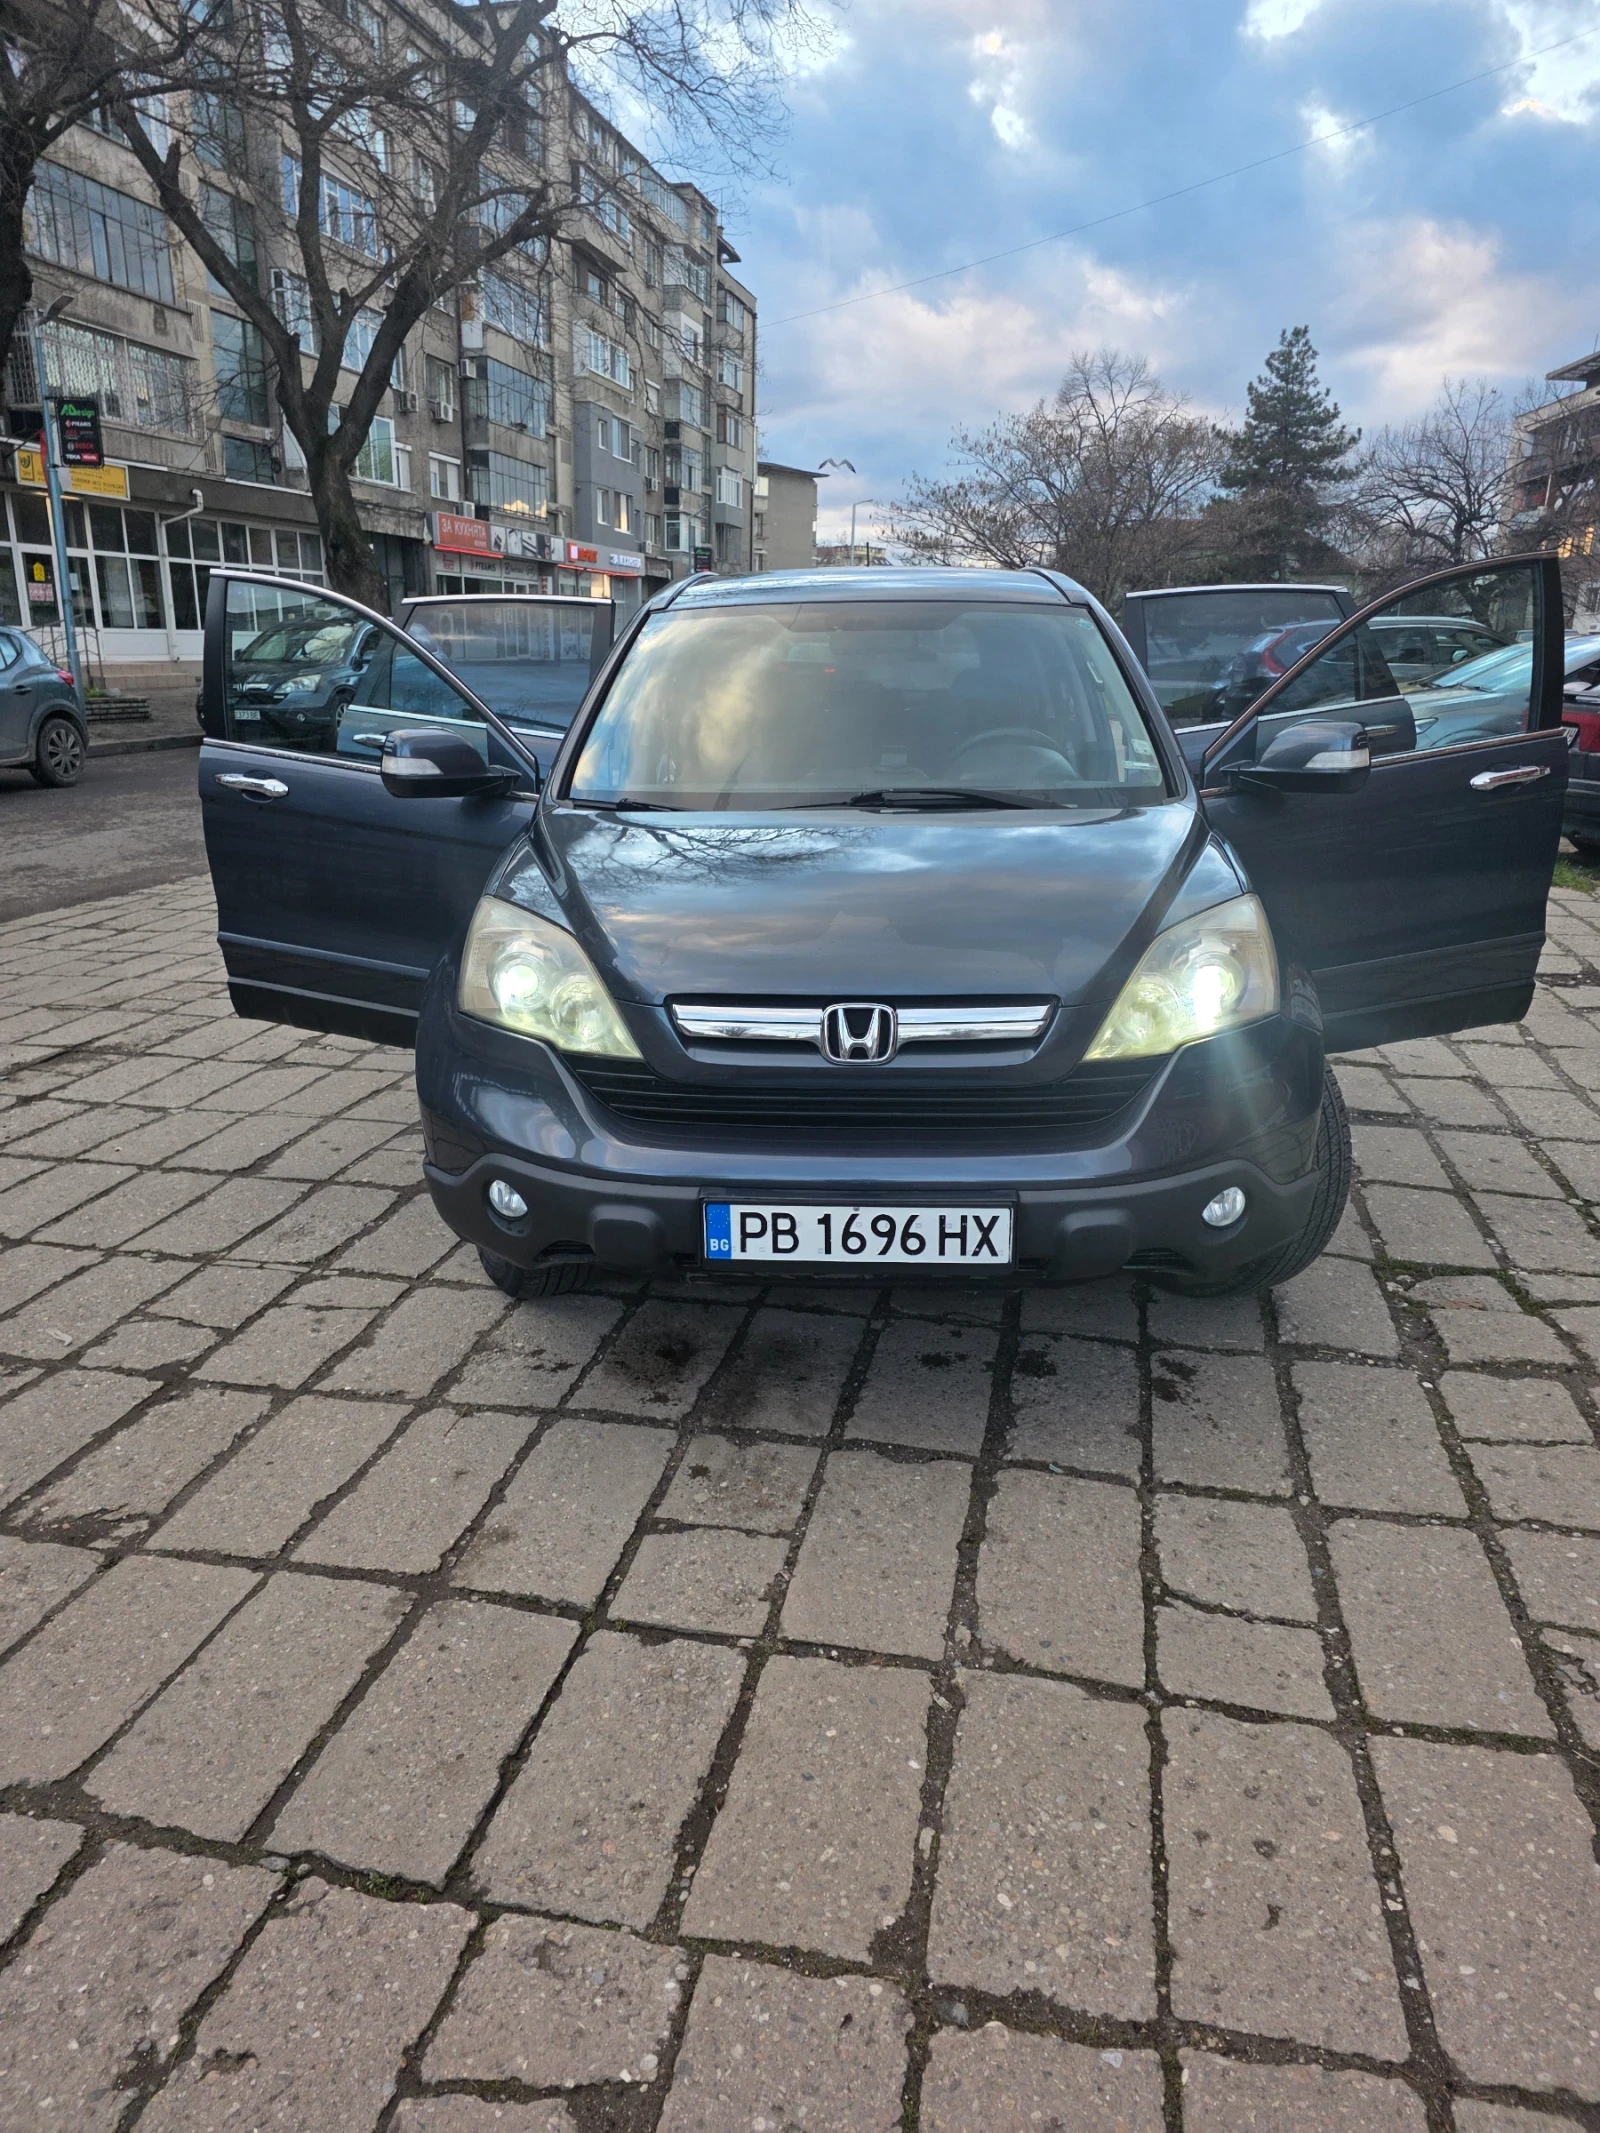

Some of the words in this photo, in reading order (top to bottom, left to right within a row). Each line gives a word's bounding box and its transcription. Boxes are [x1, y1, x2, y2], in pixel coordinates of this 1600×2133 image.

[441, 518, 453, 533] ЗА
[454, 520, 487, 540] КУХНЯТА
[475, 561, 497, 572] PYRAMIS
[739, 1211, 800, 1254] PB
[817, 1213, 927, 1256] 1696
[938, 1214, 1000, 1257] HX
[709, 1238, 729, 1251] BG
